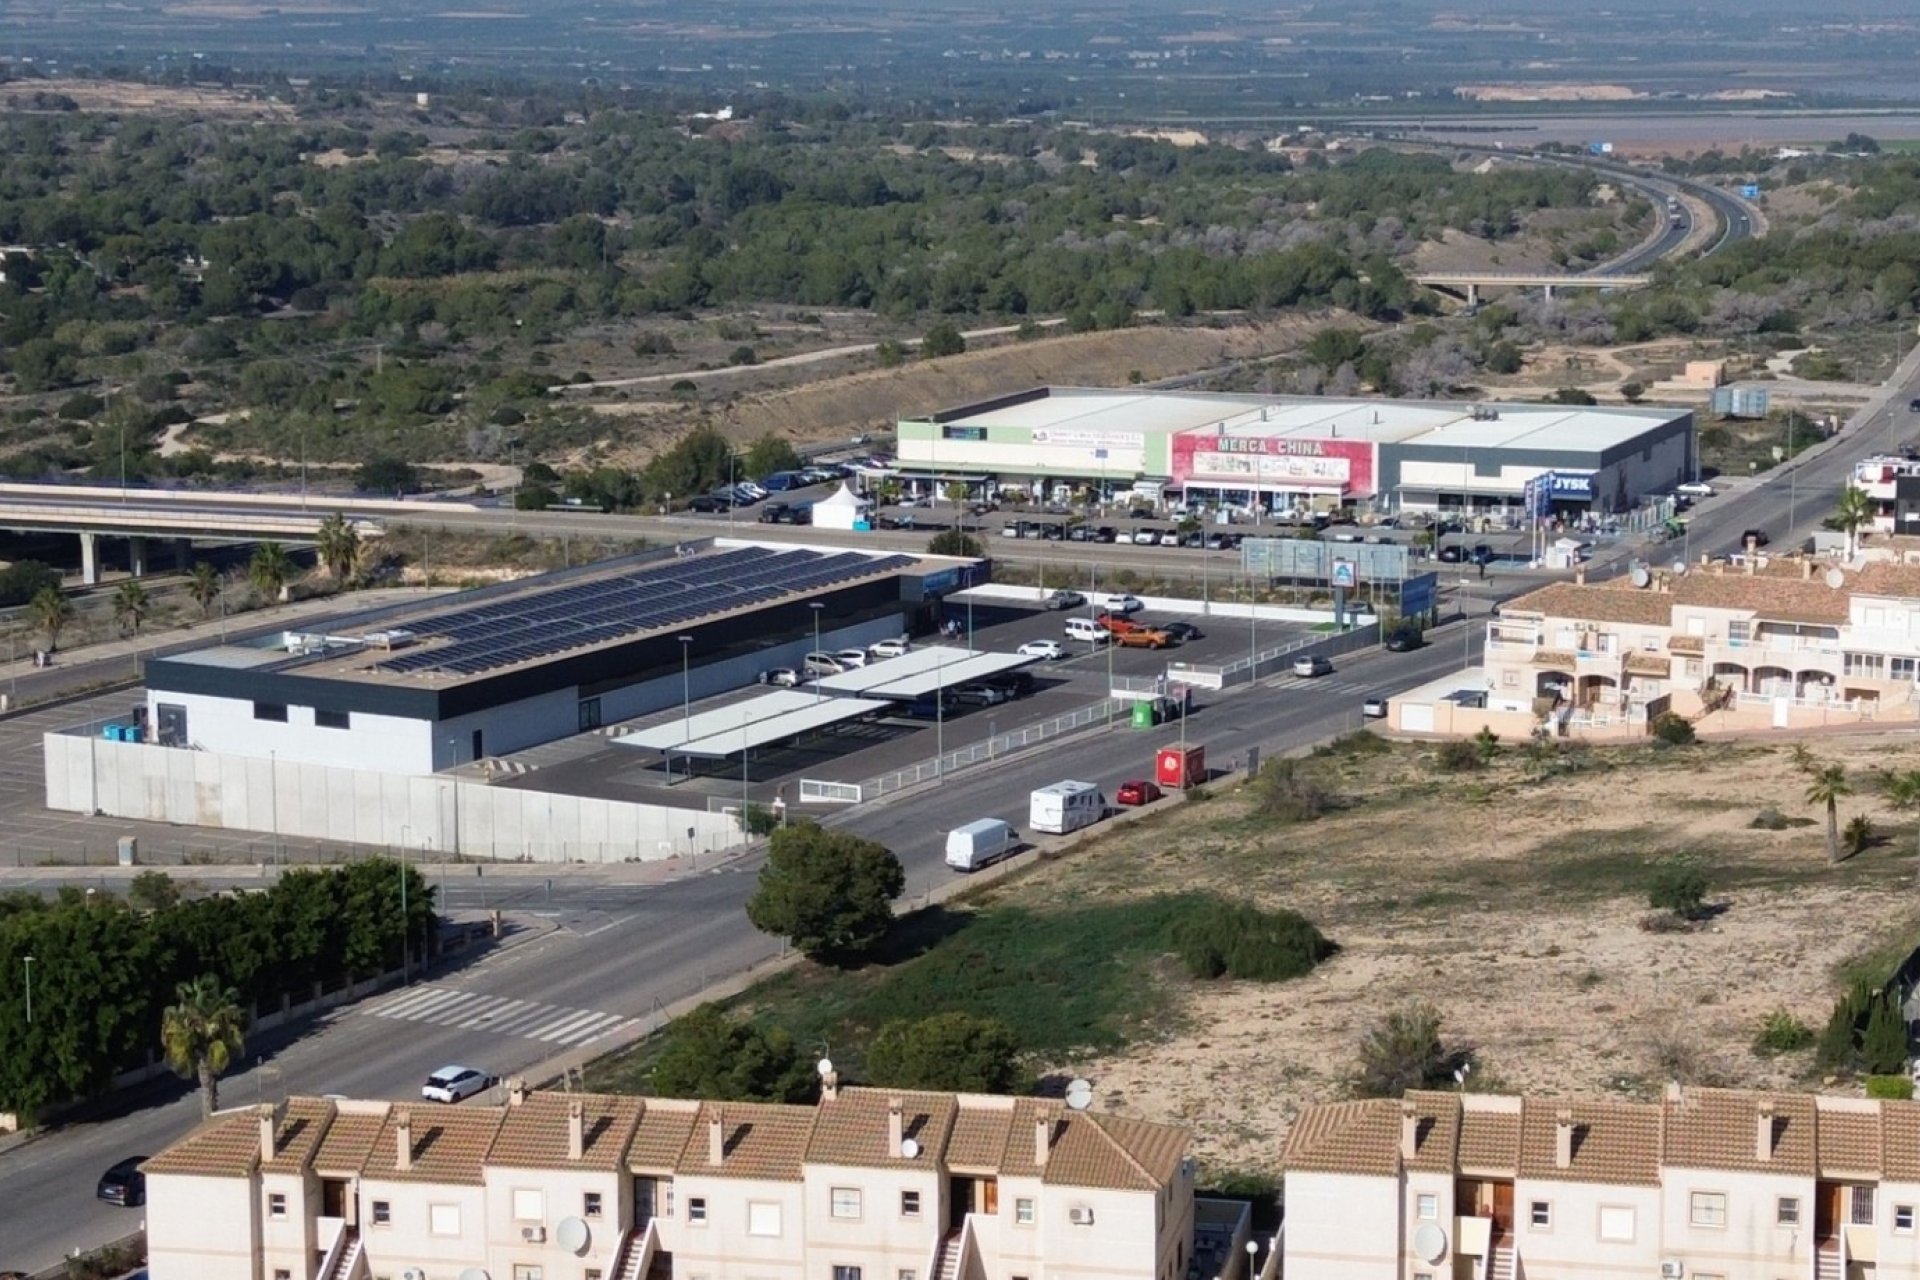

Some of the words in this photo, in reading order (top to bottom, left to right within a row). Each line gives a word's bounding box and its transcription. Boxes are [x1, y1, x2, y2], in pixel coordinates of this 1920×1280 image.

[1219, 438, 1267, 453] MERCA
[1278, 441, 1324, 455] CHINA
[1553, 477, 1590, 491] JYSK
